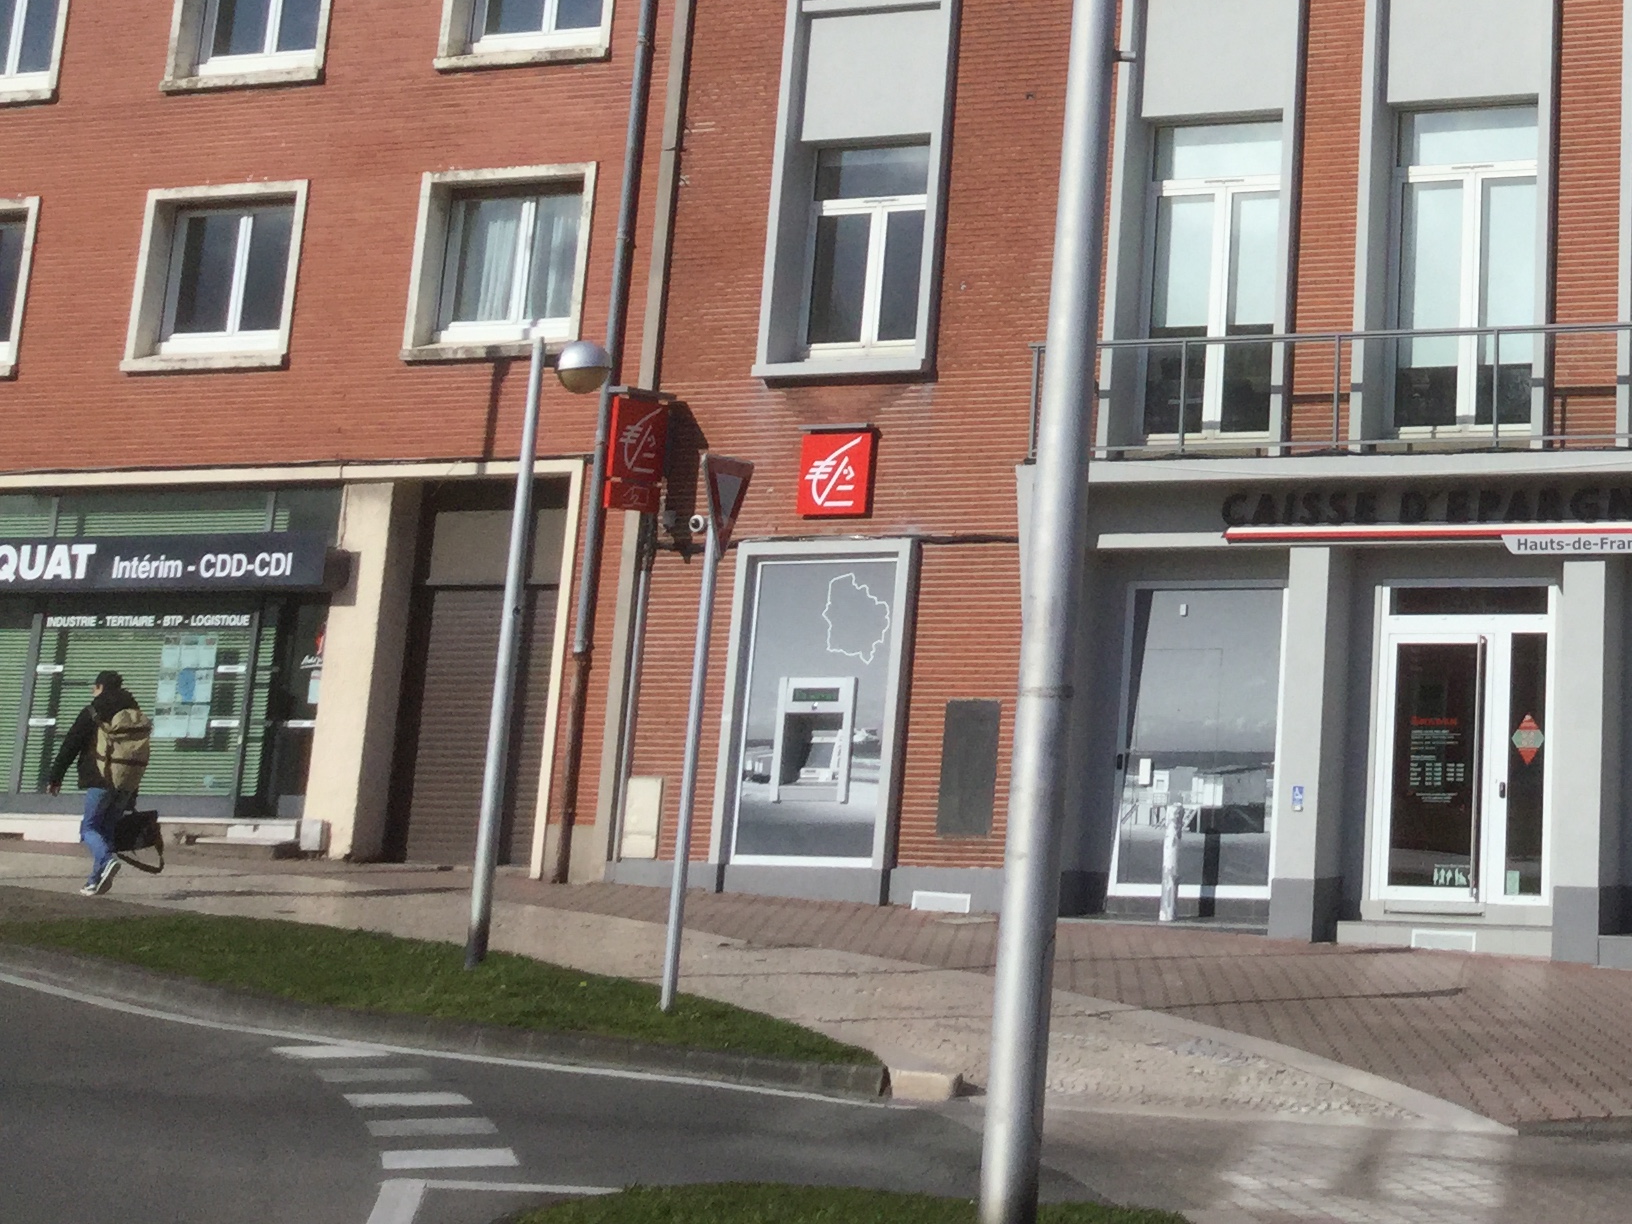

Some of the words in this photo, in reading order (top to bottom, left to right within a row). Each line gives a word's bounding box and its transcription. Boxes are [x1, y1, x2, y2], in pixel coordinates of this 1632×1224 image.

[1221, 490, 1377, 526] CAISSE
[112, 554, 182, 579] Intérim
[200, 552, 293, 578] CDD-CDI
[46, 616, 97, 627] INDUSTRIE
[105, 615, 155, 627] TERTIAIRE
[163, 615, 183, 626] BTP
[190, 614, 250, 626] LOGISTIQUE
